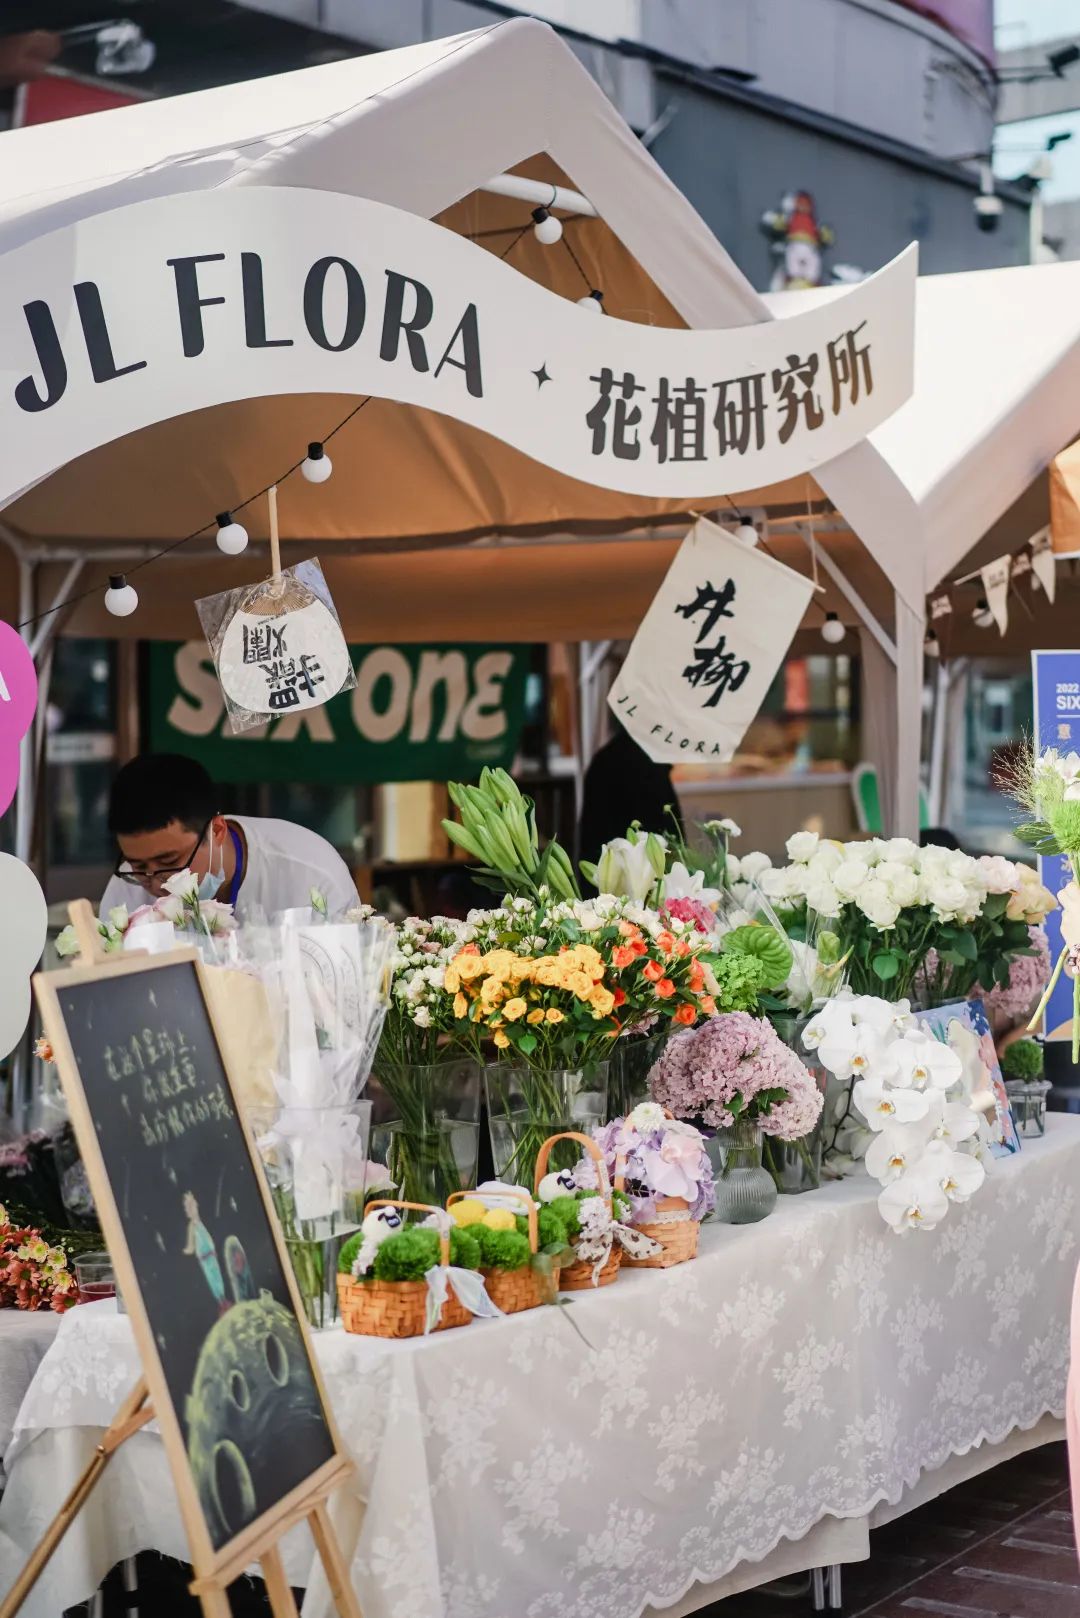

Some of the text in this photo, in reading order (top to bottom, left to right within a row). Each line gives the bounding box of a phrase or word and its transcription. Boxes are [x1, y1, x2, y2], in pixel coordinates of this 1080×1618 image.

[14, 252, 483, 413] JL FLORA
[586, 320, 873, 464] 花植研究所
[1056, 683, 1079, 694] 2022
[1056, 695, 1080, 710] SIX
[617, 696, 720, 754] JL FLORA
